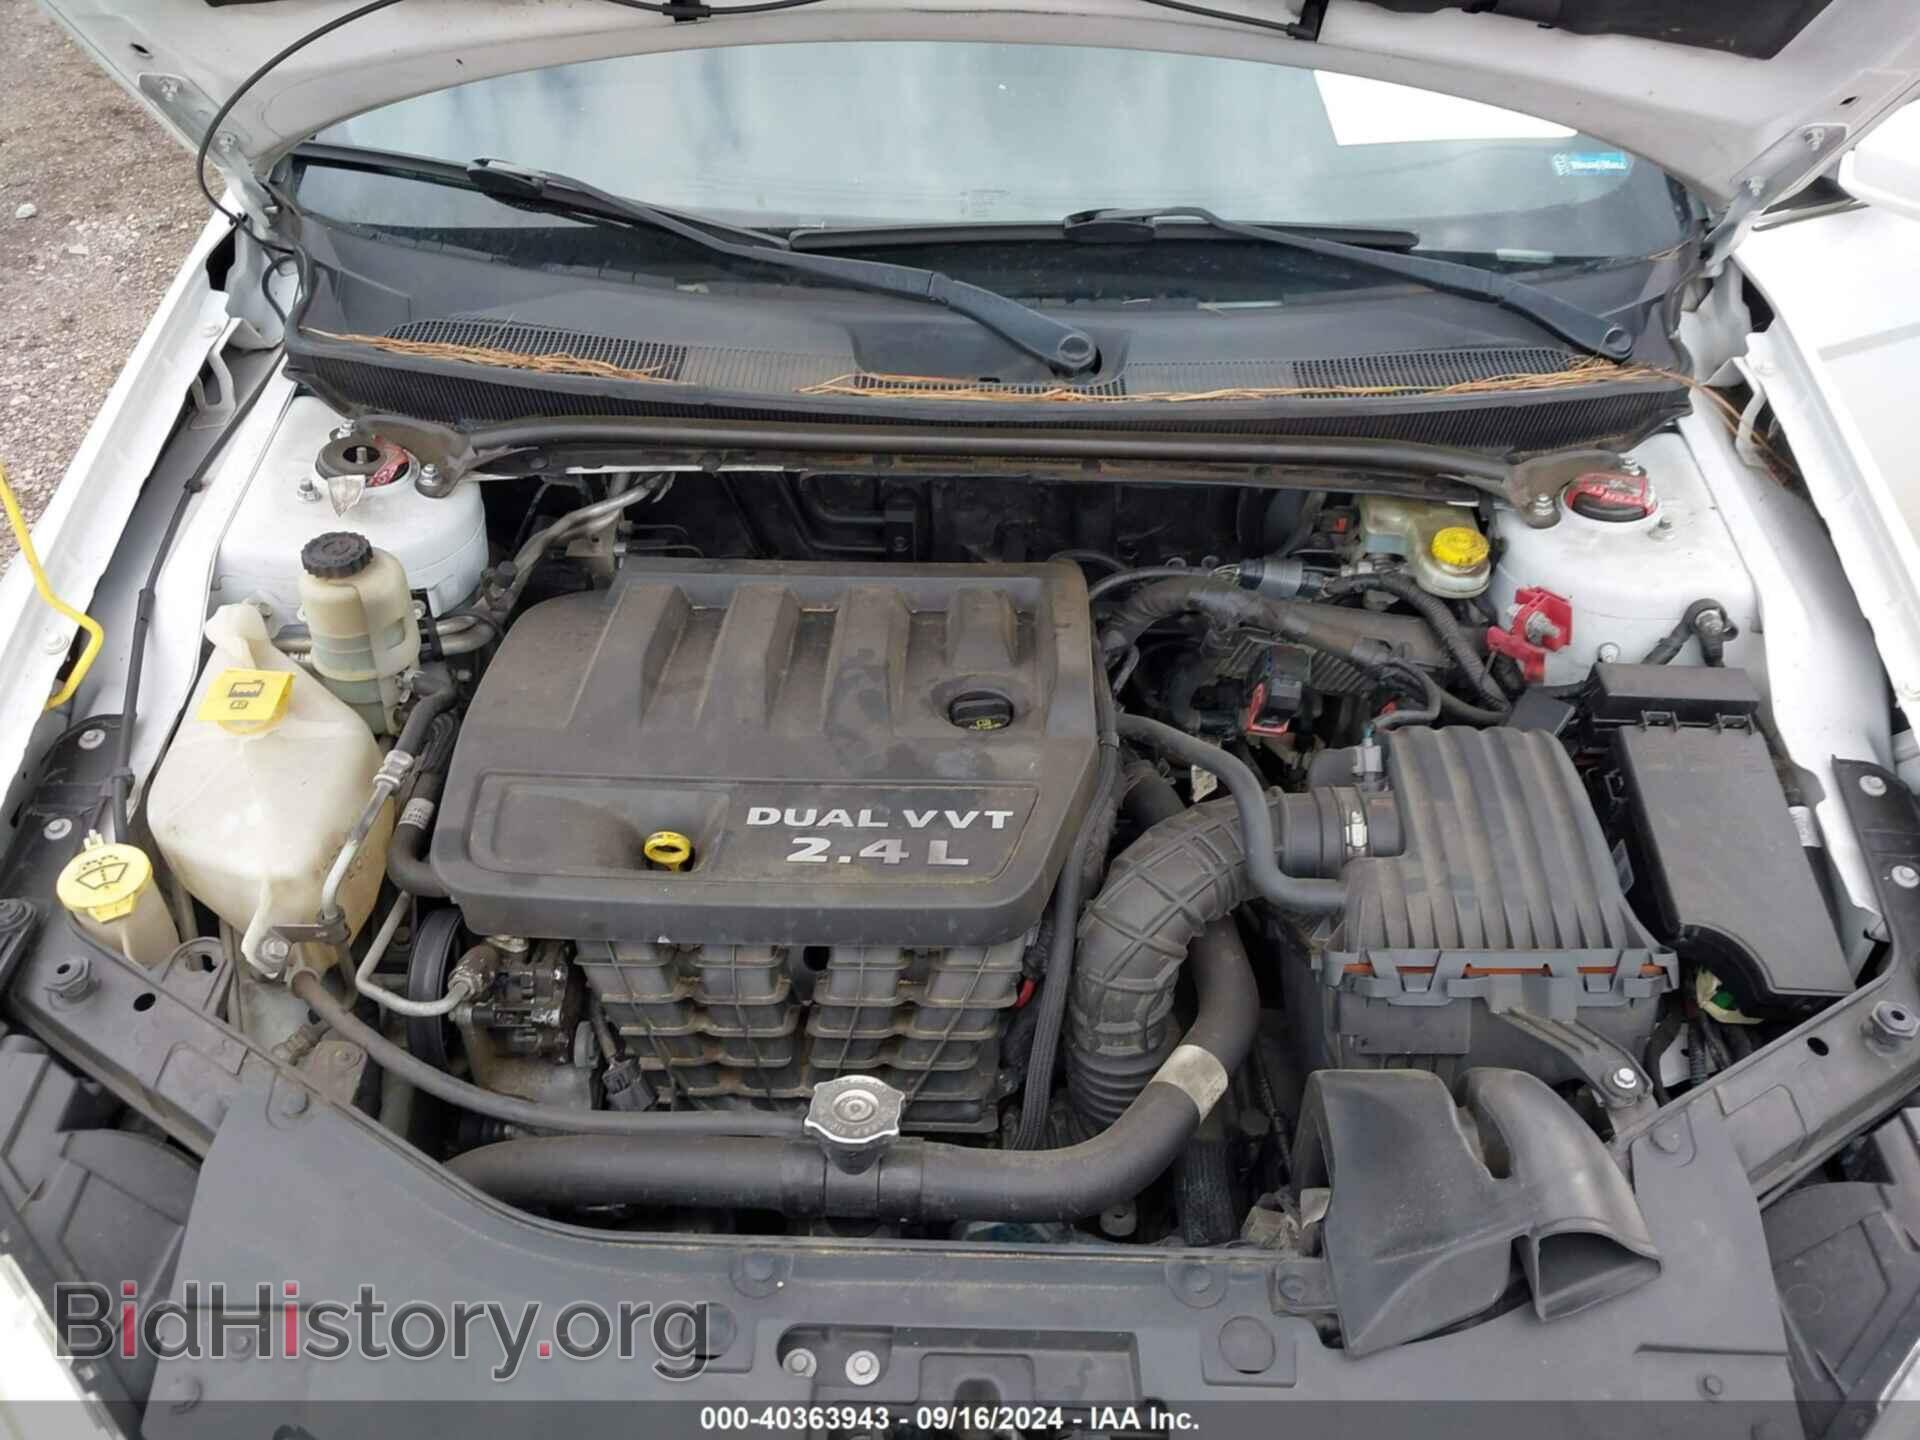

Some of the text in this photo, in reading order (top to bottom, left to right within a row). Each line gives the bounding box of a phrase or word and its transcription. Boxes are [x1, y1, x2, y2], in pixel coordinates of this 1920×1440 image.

[746, 807, 1015, 829] DUAL VVT
[786, 836, 970, 866] 2.4 L
